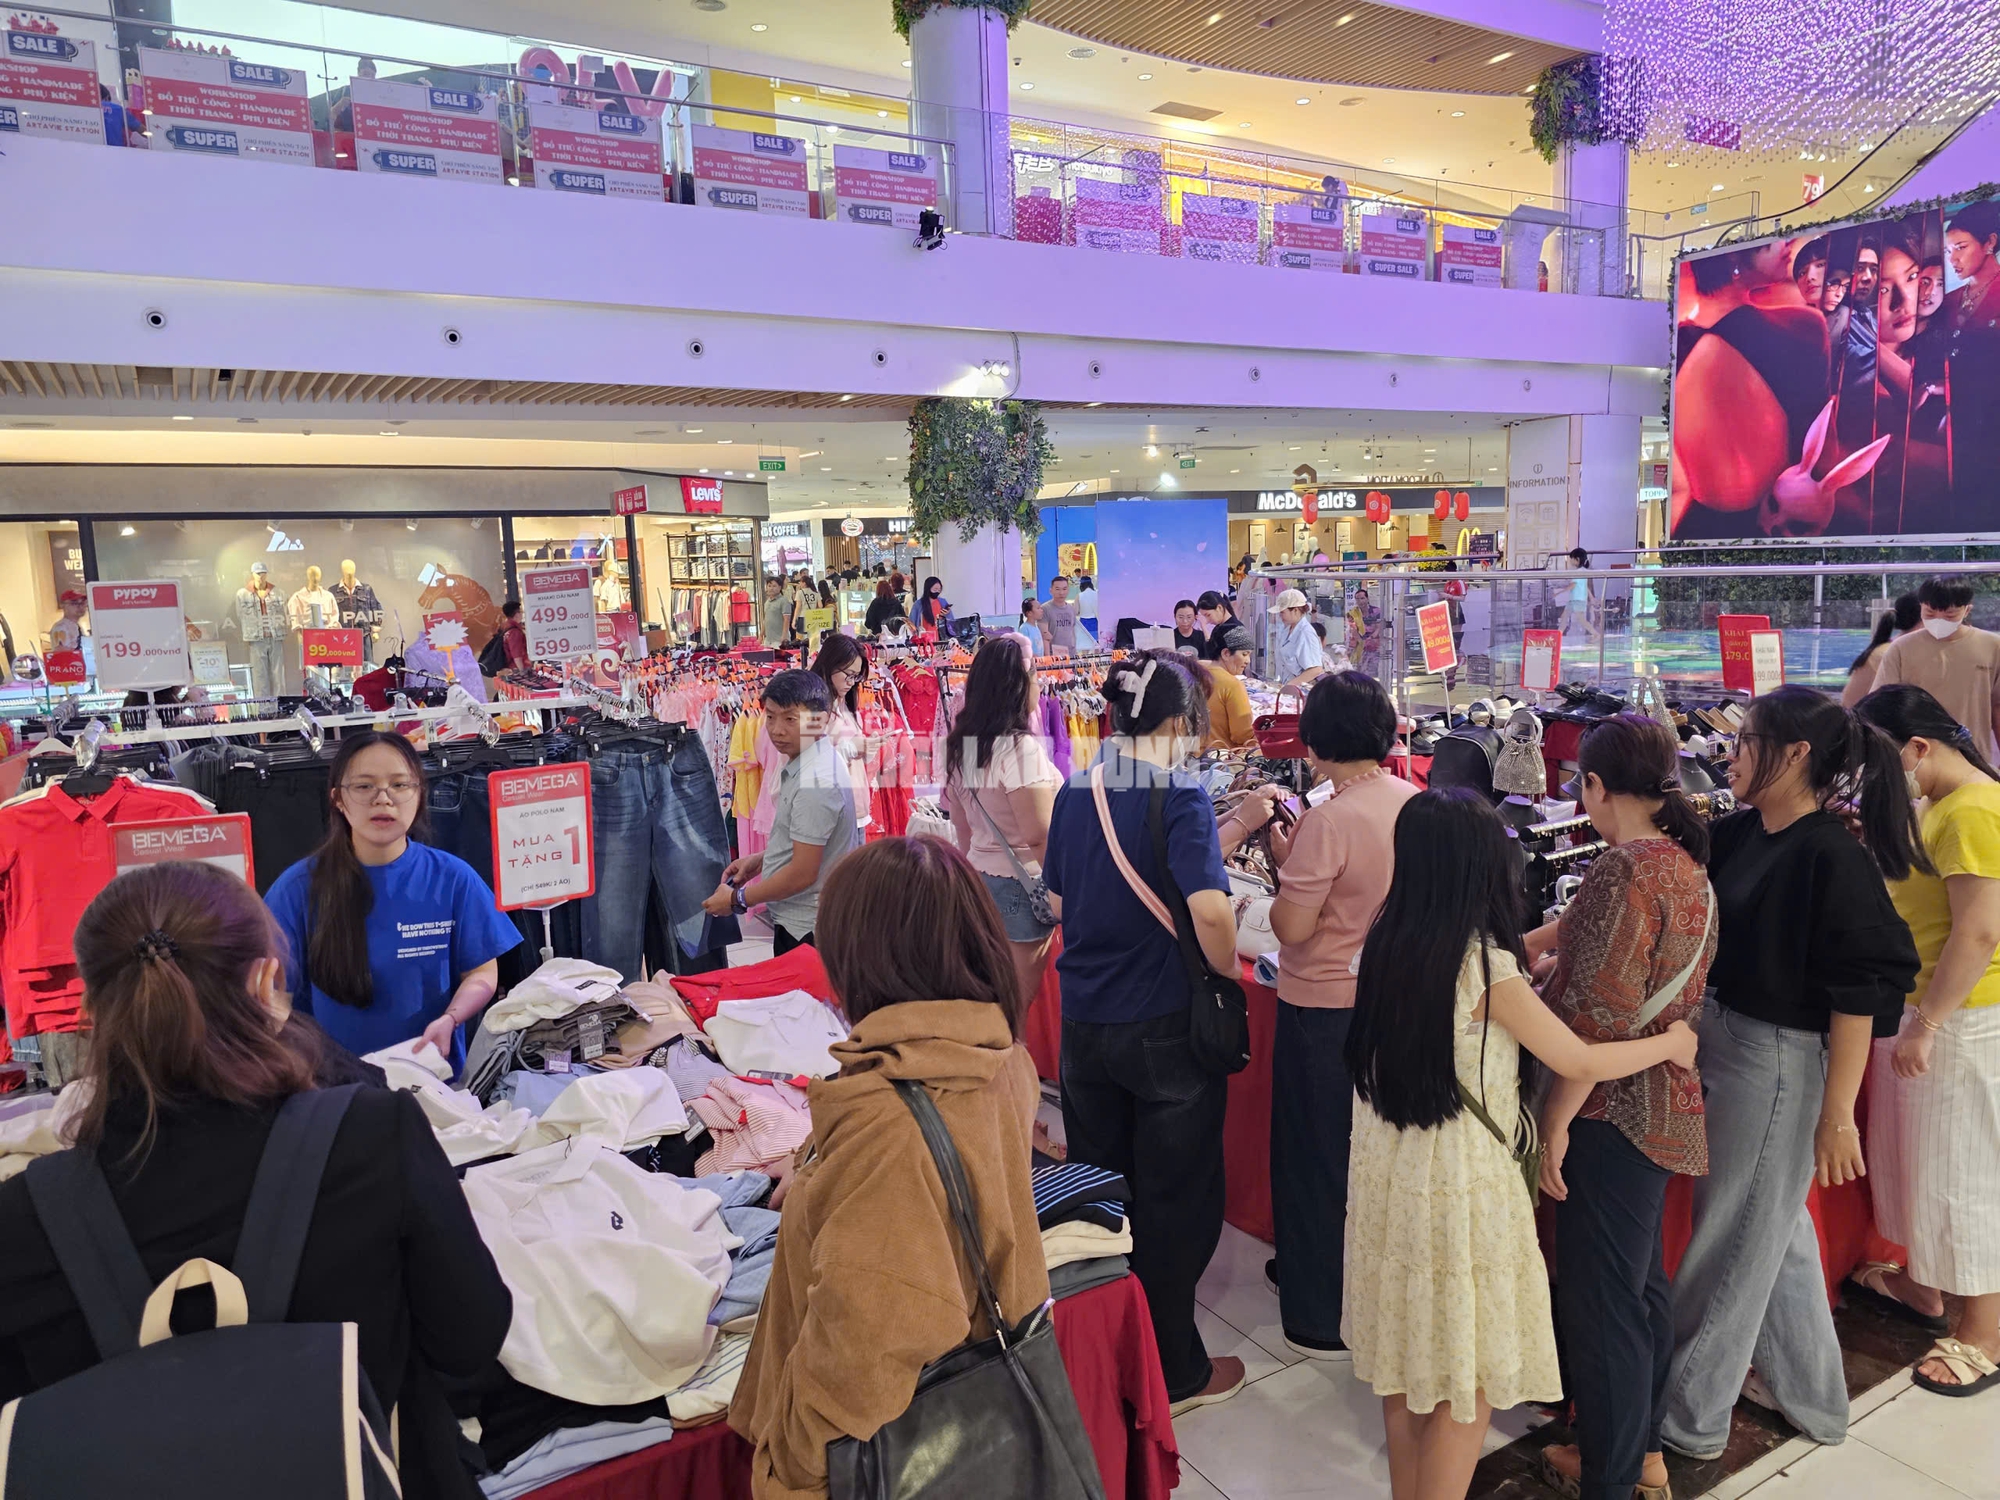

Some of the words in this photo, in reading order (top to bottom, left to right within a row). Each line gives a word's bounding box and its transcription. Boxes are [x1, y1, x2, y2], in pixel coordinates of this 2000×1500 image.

[13, 36, 58, 53] SALE
[234, 65, 274, 81] SALE
[20, 76, 85, 90] HANDMADE
[199, 87, 257, 101] WORKSHOP
[433, 92, 468, 107] SALE
[199, 109, 234, 120] TRANG
[239, 103, 297, 117] HANDMADE
[402, 113, 453, 126] WORKSHOP
[601, 115, 633, 130] SALE
[65, 126, 99, 134] STATION
[438, 127, 488, 141] HANDMADE
[183, 130, 237, 148] SUPER
[402, 133, 433, 144] TRANG
[575, 136, 619, 147] WORKSHOP
[756, 136, 784, 149] SALE
[279, 149, 310, 158] STATION
[388, 153, 435, 171] SUPER
[891, 155, 916, 167] SALE
[562, 174, 604, 189] SUPER
[720, 191, 757, 206] SUPER
[859, 208, 891, 221] SUPER
[1313, 210, 1330, 220] SALE
[1398, 221, 1414, 230] SALE
[1476, 230, 1492, 239] SALE
[1288, 255, 1310, 265] SUPER
[1375, 263, 1395, 272] SUPER
[1396, 265, 1413, 274] SALE
[1454, 271, 1473, 280] SUPER
[763, 462, 778, 470] EXIT
[1510, 476, 1566, 489] INFORMATION
[773, 525, 799, 537] COFFEE
[533, 573, 580, 587] BEMEGA
[114, 587, 157, 600] pypoy
[501, 772, 578, 796] BEMEGA
[531, 809, 549, 817] POLO
[132, 825, 227, 849] BEMEGA
[133, 846, 161, 856] Casual
[164, 845, 187, 853] Wear
[513, 834, 555, 849] MUA
[563, 825, 581, 865] 1
[508, 851, 562, 869] TẶNG
[402, 930, 418, 938] HAVE
[419, 928, 444, 936] NOTHING
